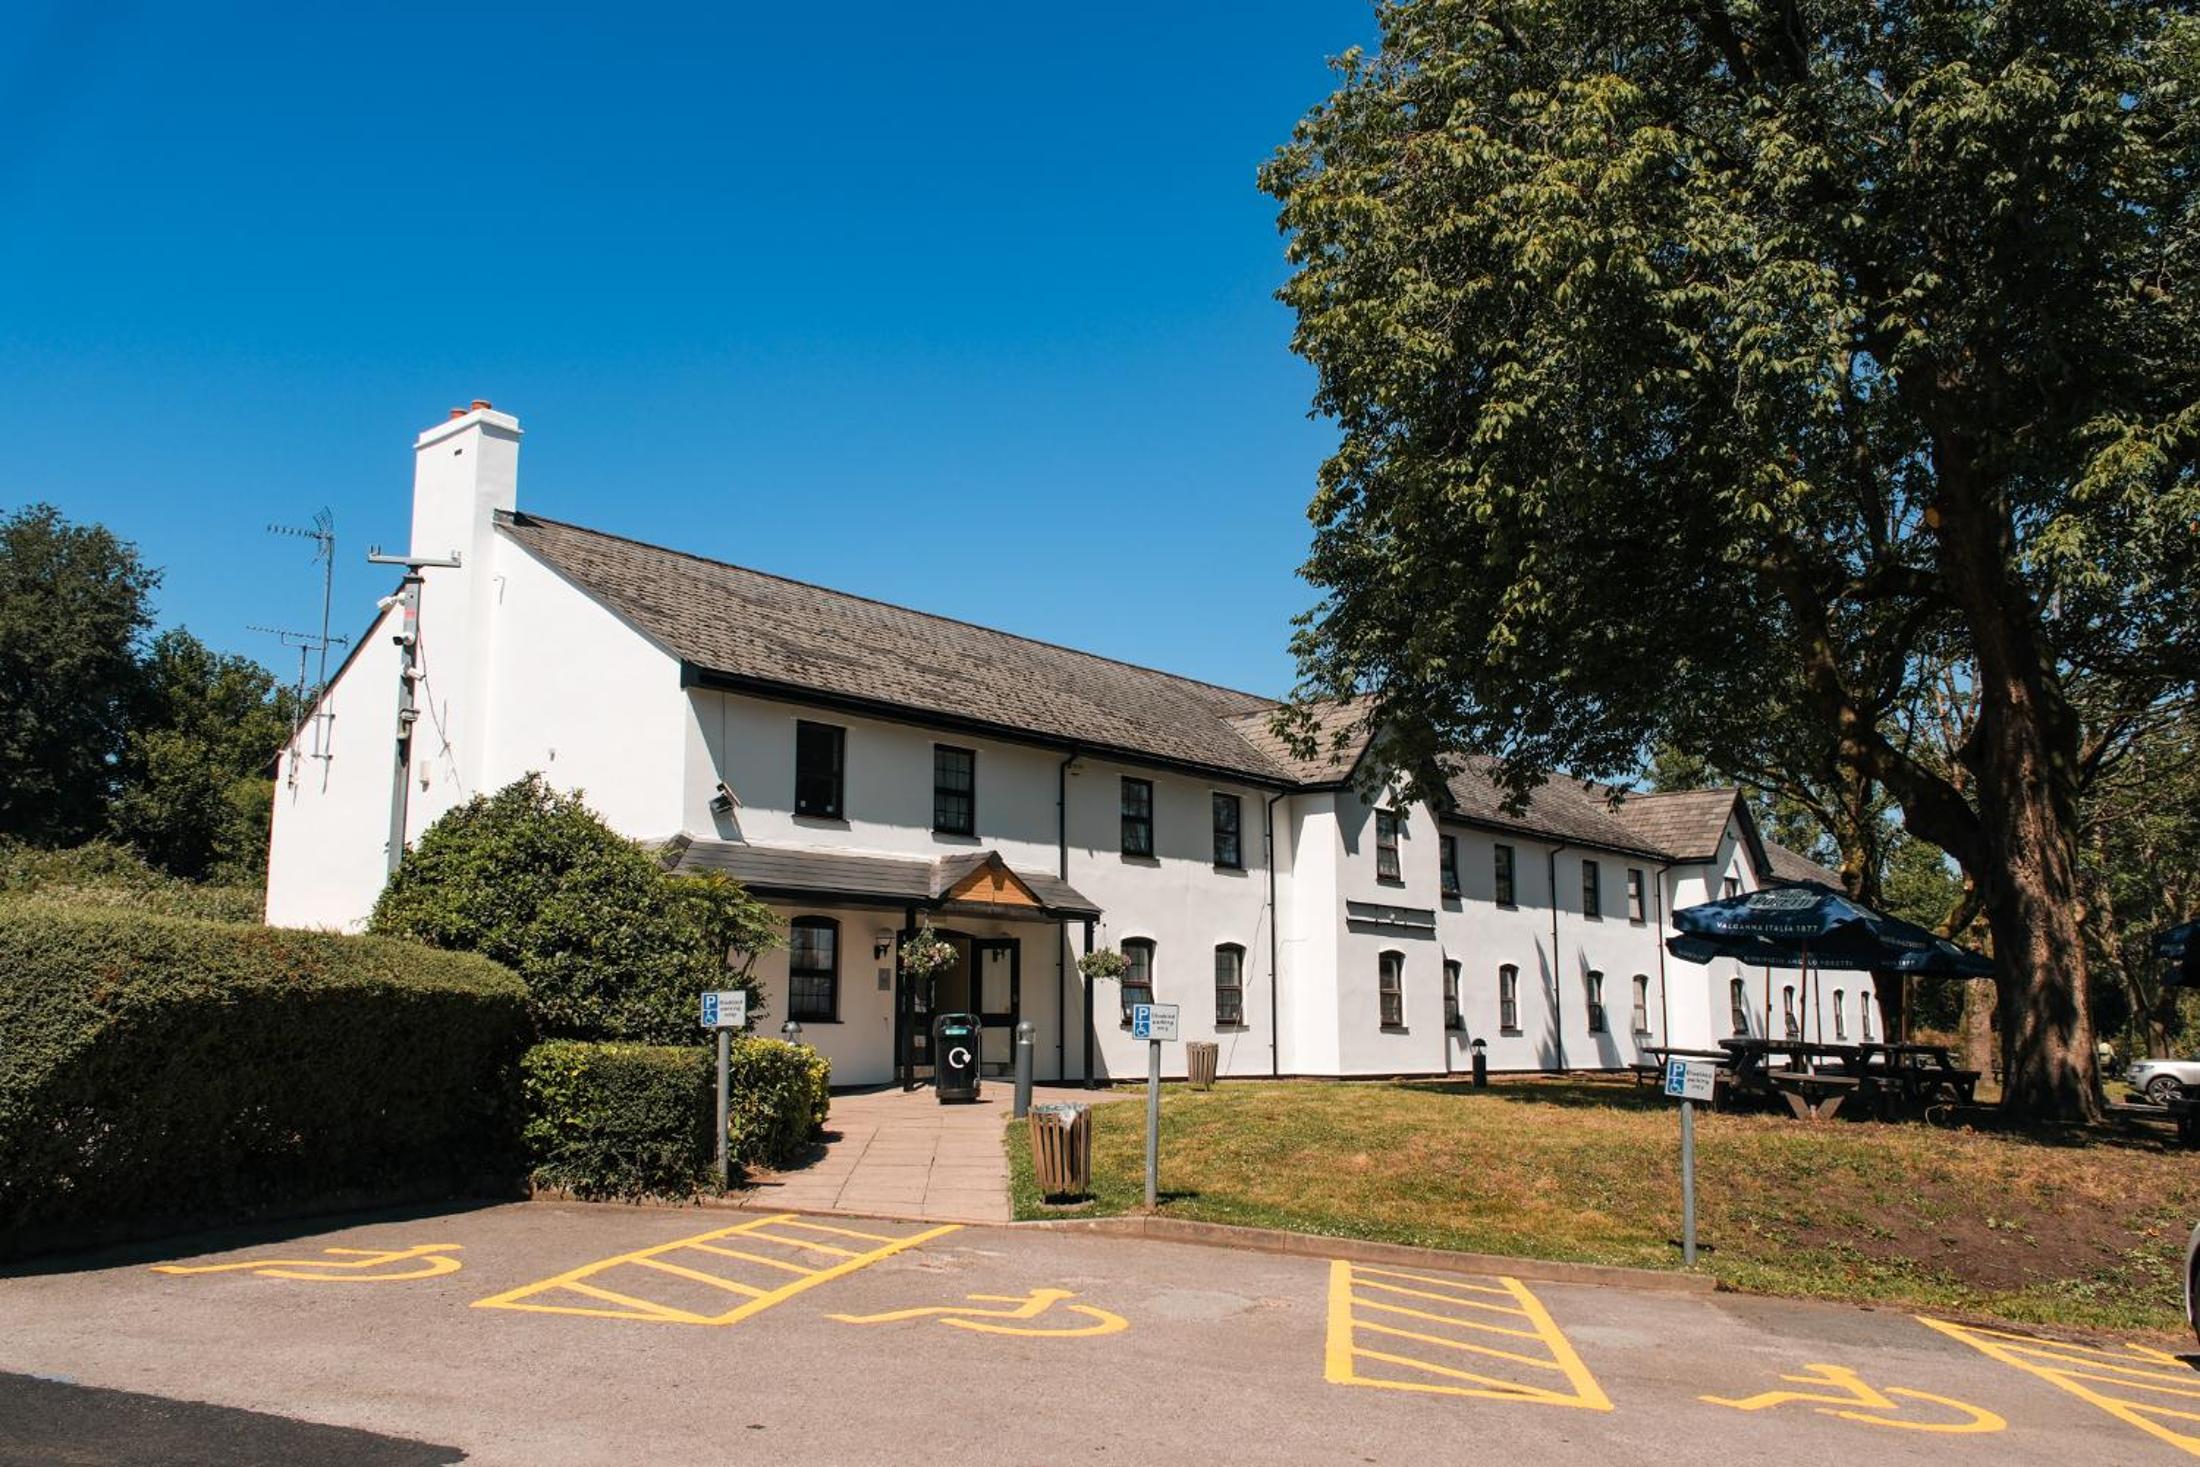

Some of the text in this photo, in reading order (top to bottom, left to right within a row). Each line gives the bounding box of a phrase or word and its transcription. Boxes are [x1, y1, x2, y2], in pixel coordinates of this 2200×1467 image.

[1765, 923, 1793, 933] ITALIA
[706, 995, 717, 1009] P
[1139, 1007, 1150, 1021] P
[1673, 1063, 1684, 1077] P
